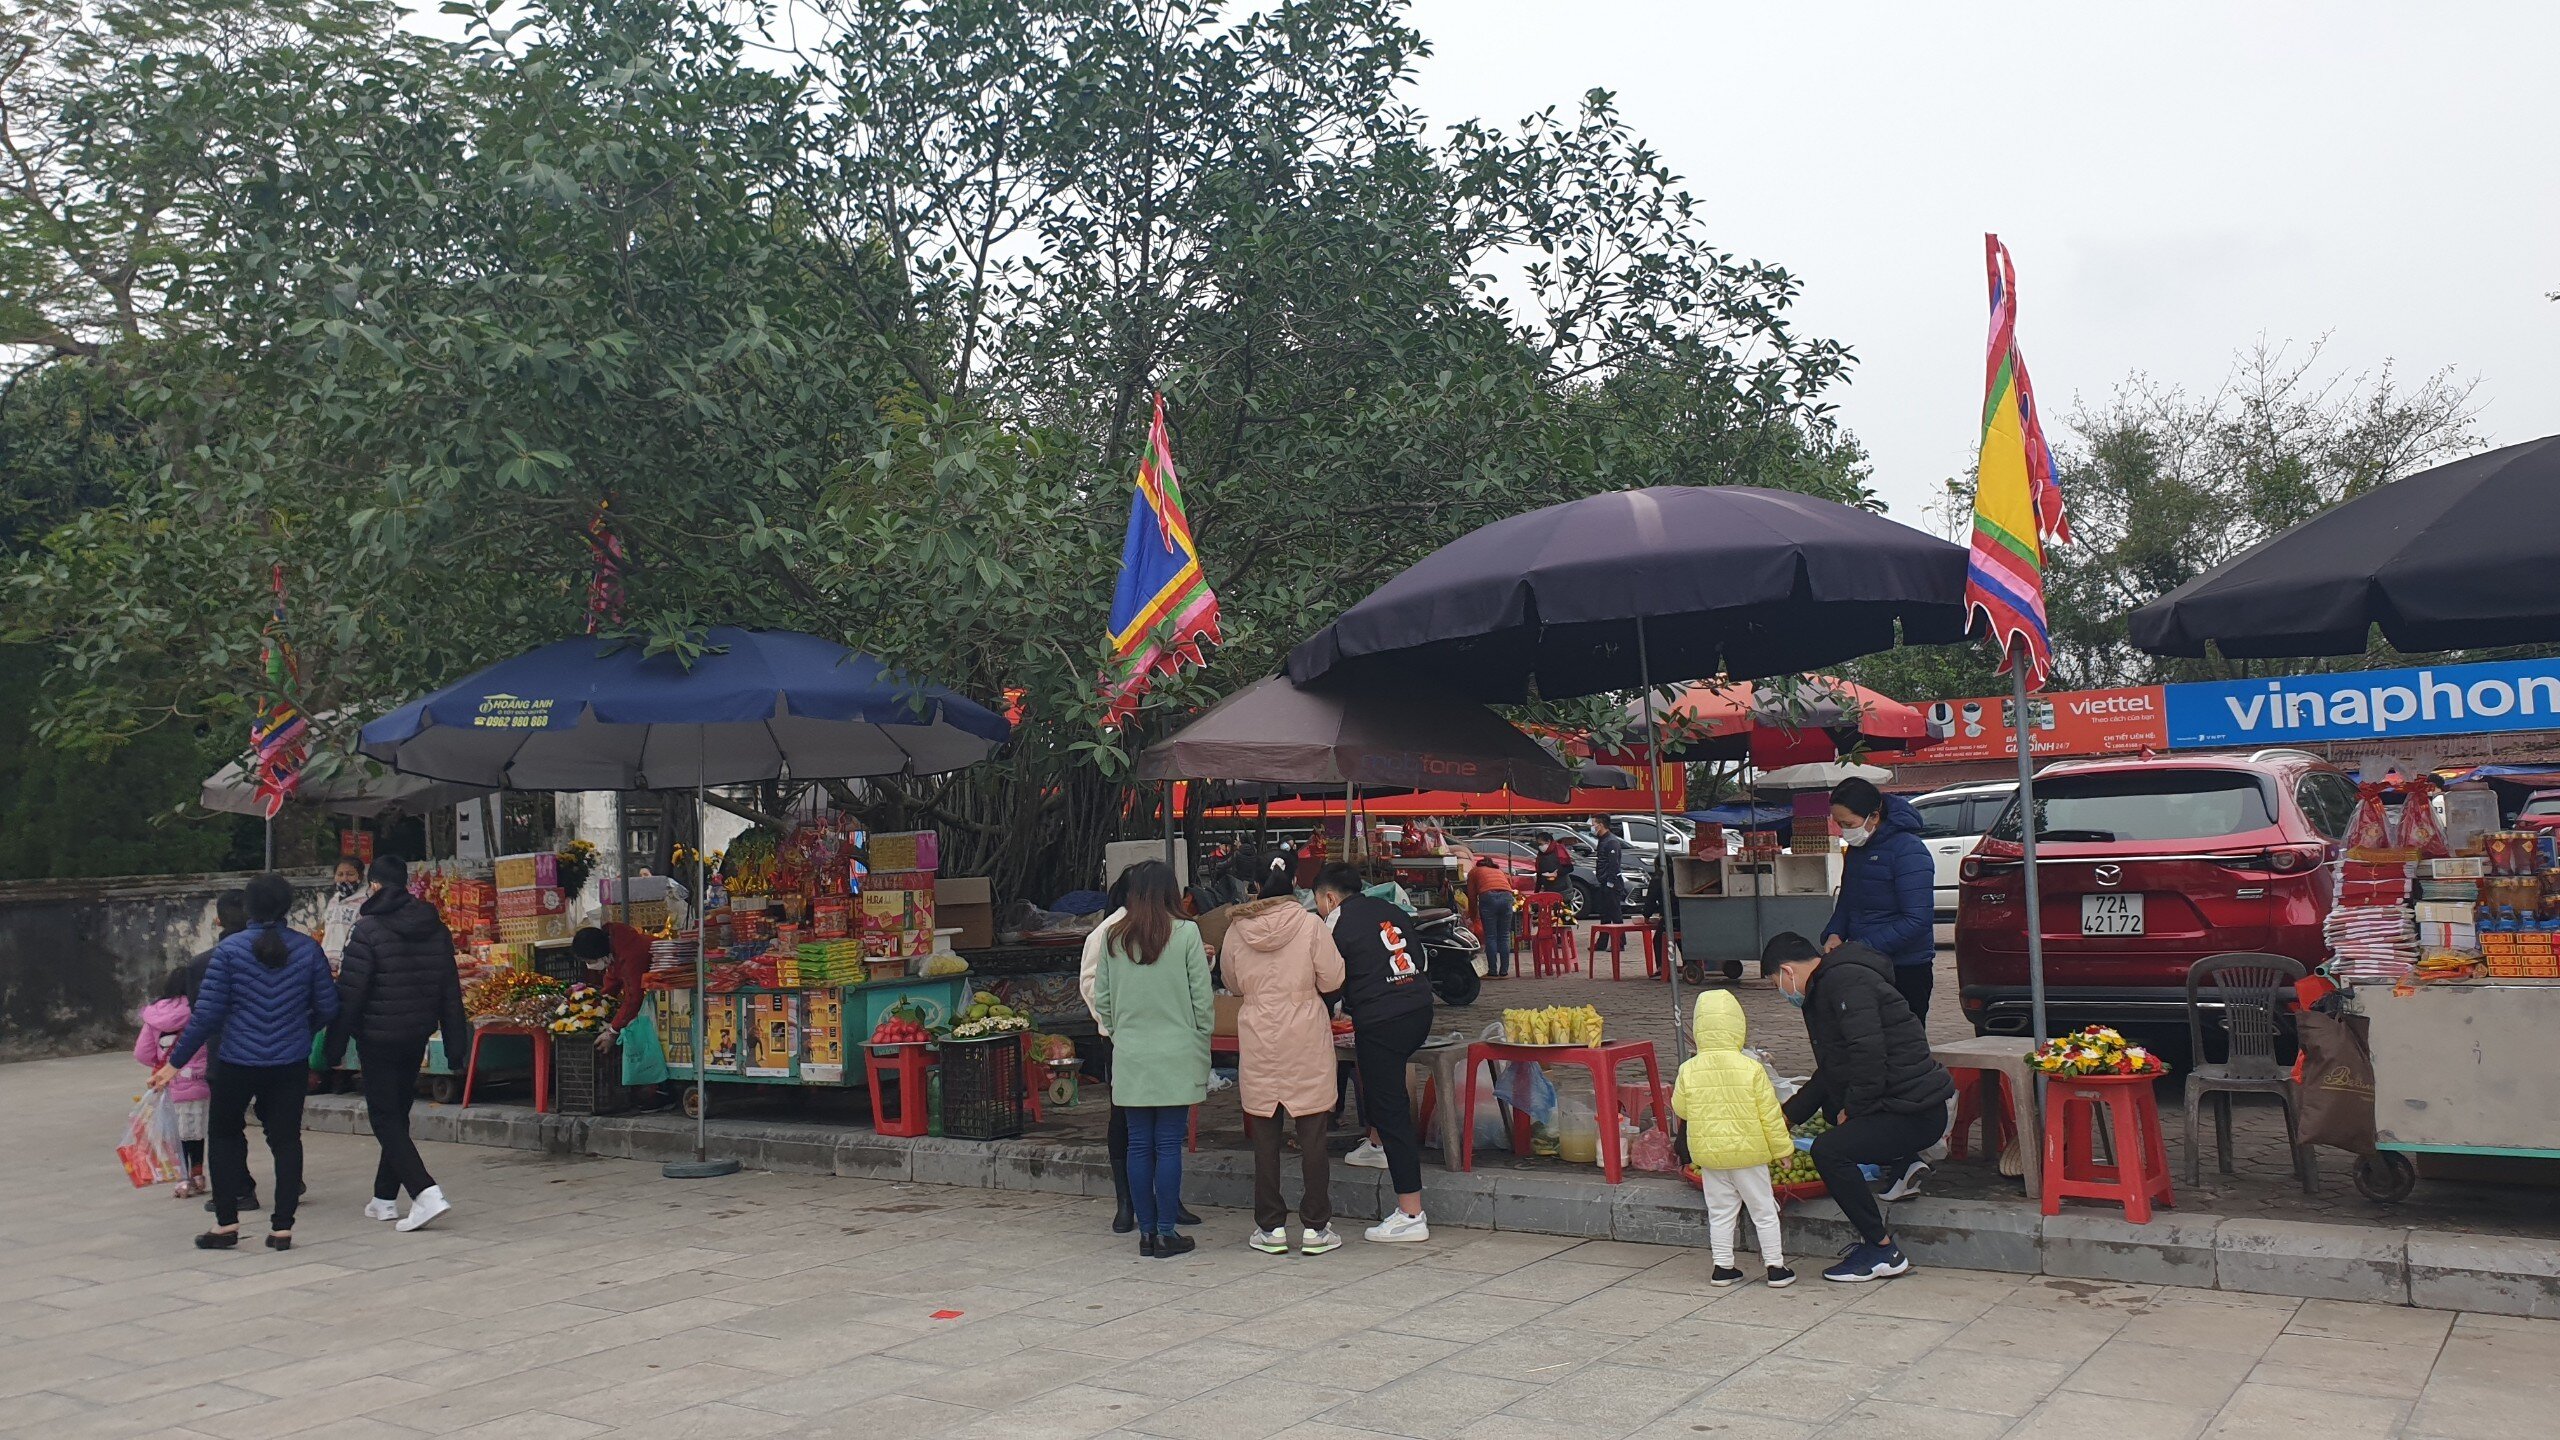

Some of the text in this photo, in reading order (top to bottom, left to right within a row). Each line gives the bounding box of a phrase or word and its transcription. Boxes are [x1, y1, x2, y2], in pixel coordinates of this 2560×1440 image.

[531, 699, 554, 708] ANH
[2069, 694, 2154, 715] viettel
[2095, 896, 2128, 914] 72A
[2084, 915, 2141, 933] 421.72
